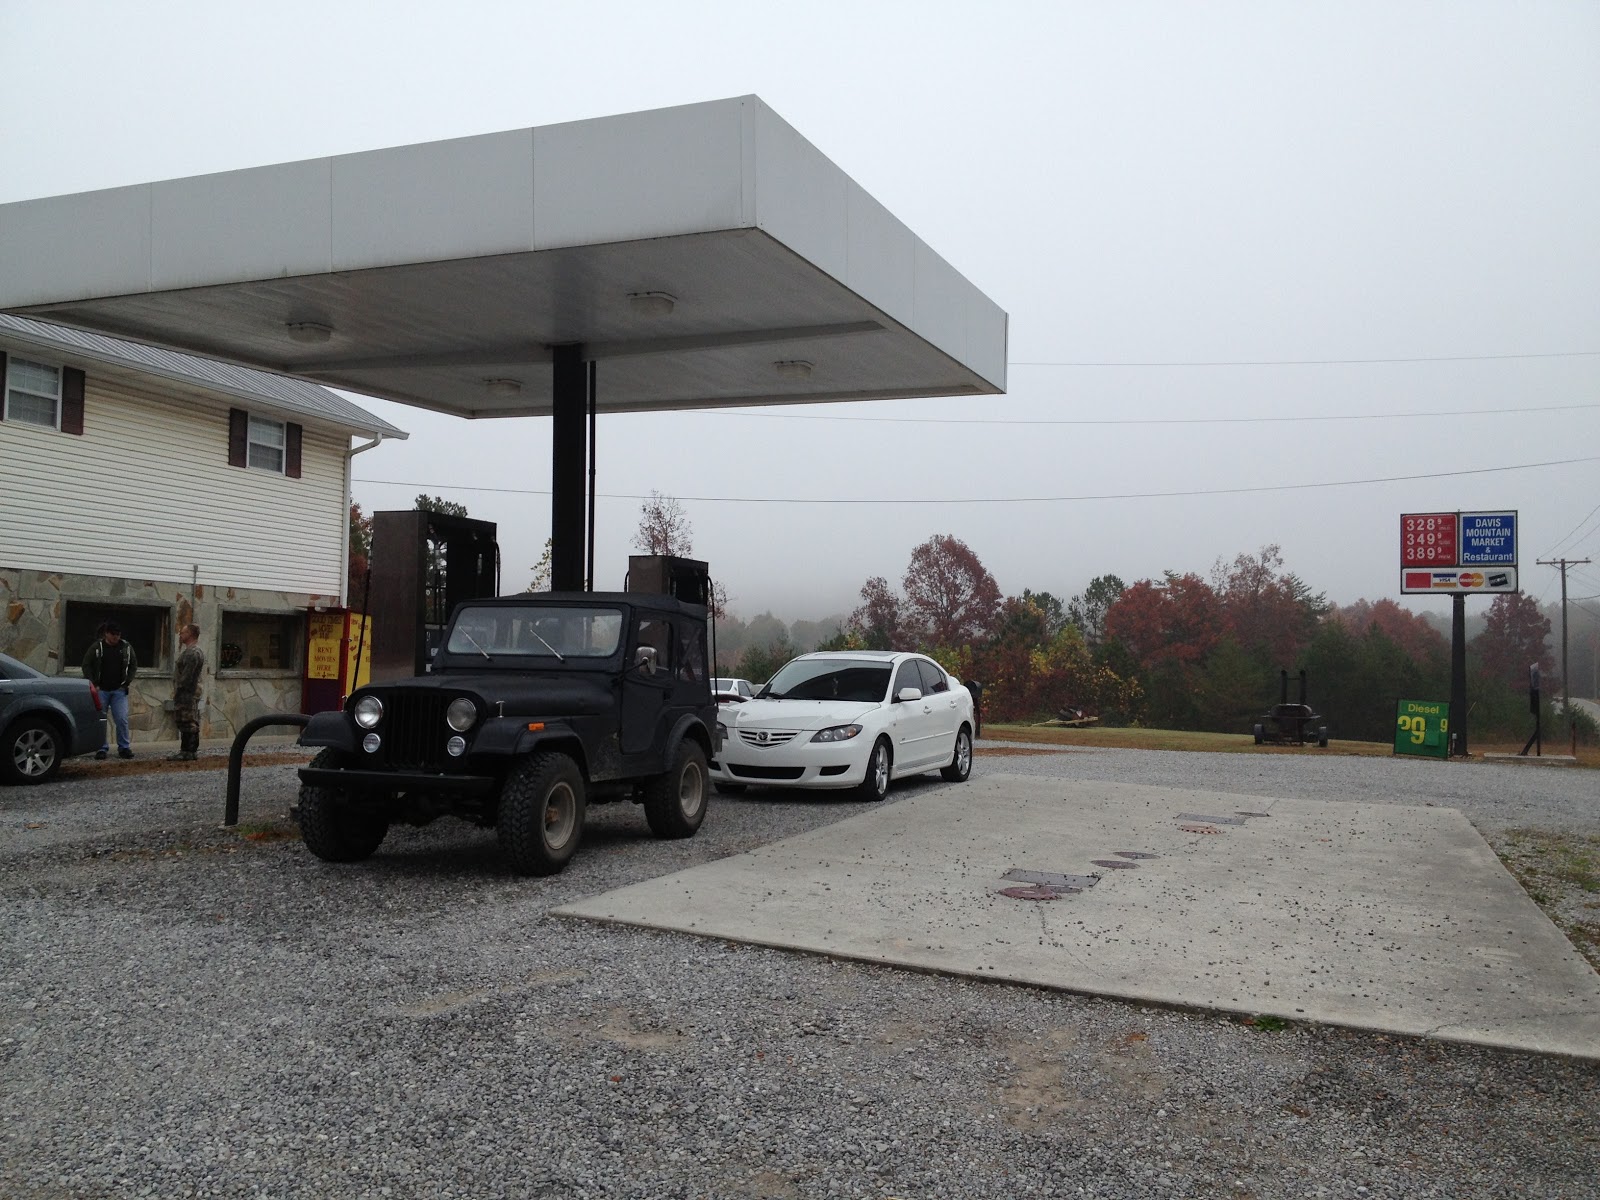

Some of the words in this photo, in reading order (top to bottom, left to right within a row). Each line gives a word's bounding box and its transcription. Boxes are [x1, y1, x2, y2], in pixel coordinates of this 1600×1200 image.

[1406, 518, 1436, 531] 328
[1475, 518, 1501, 528] DAVIS
[1466, 528, 1511, 537] MOUNTAIN
[1406, 532, 1436, 546] 349
[1471, 537, 1505, 546] MARKET
[1406, 547, 1436, 560] 389
[1463, 552, 1513, 561] Restaurant
[1408, 703, 1440, 714] Diesel
